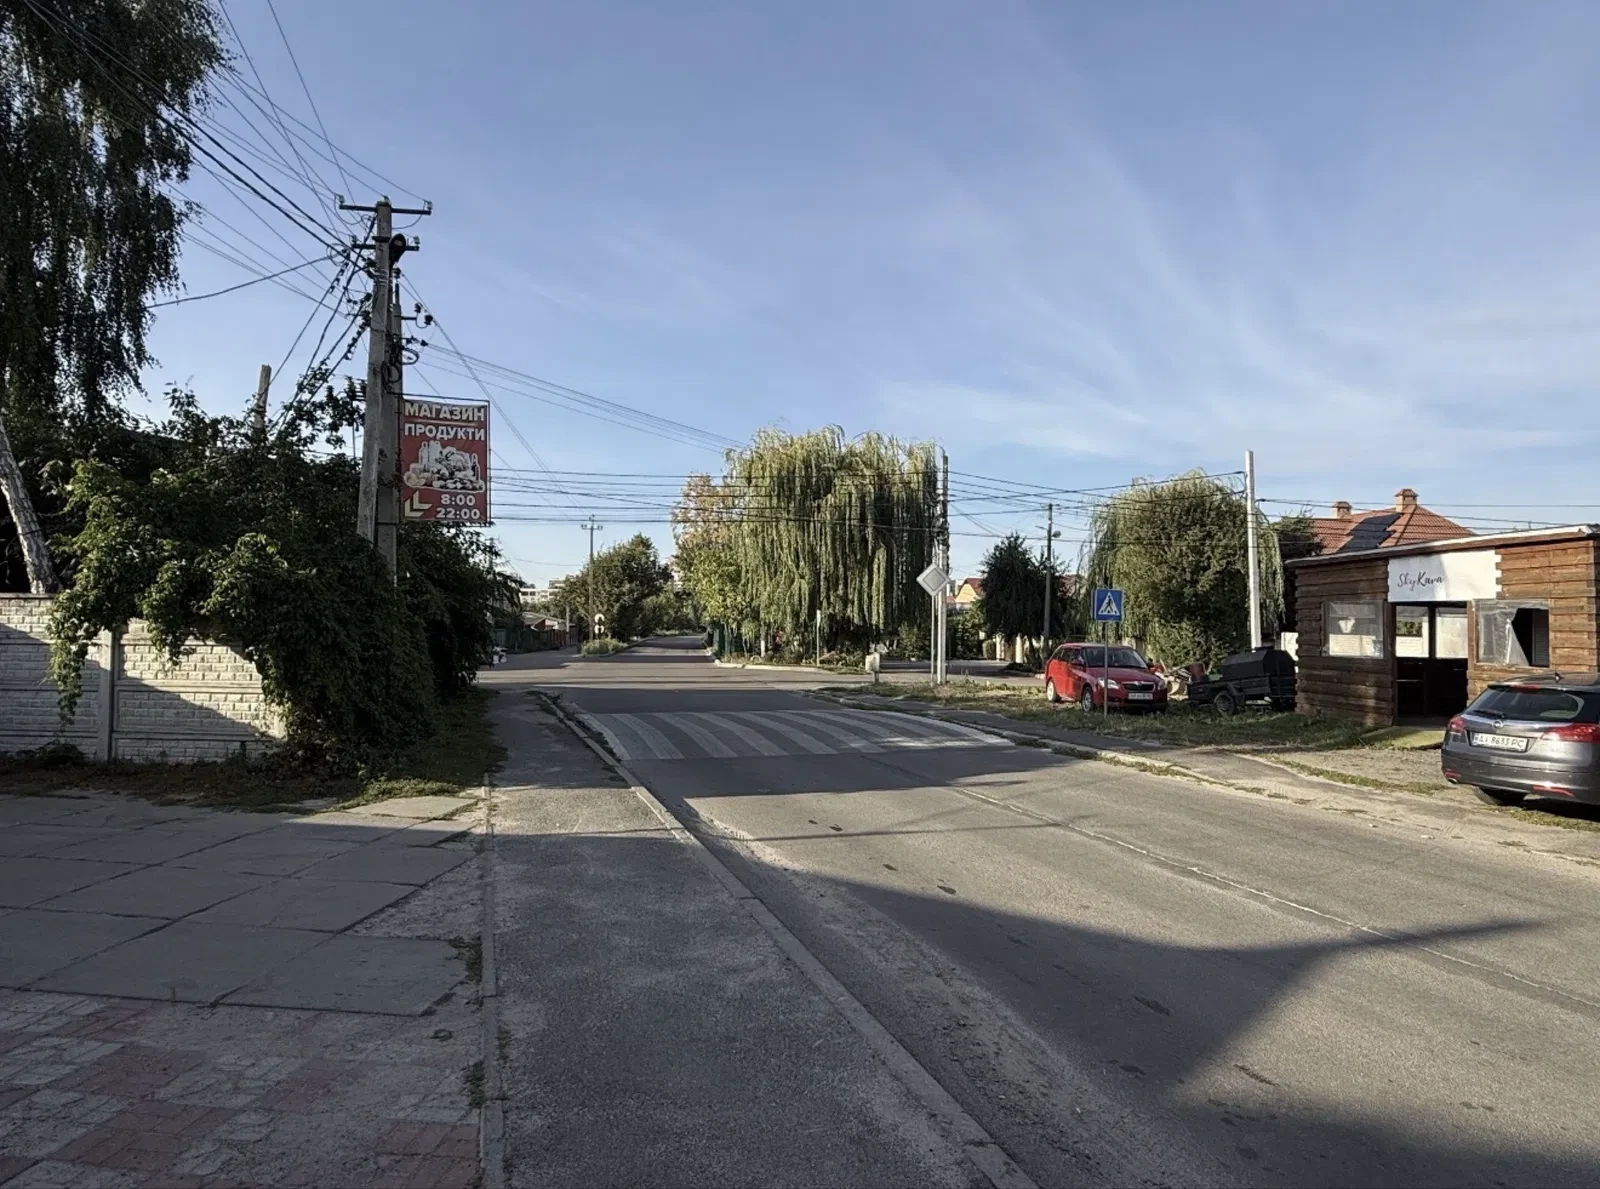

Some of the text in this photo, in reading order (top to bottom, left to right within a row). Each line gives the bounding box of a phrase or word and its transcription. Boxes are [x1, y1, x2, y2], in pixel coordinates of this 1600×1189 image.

[404, 402, 485, 421] МАГАЗИН
[404, 423, 485, 441] ПРОДУКТИ
[441, 494, 476, 506] 8:00
[436, 508, 481, 519] 22:00
